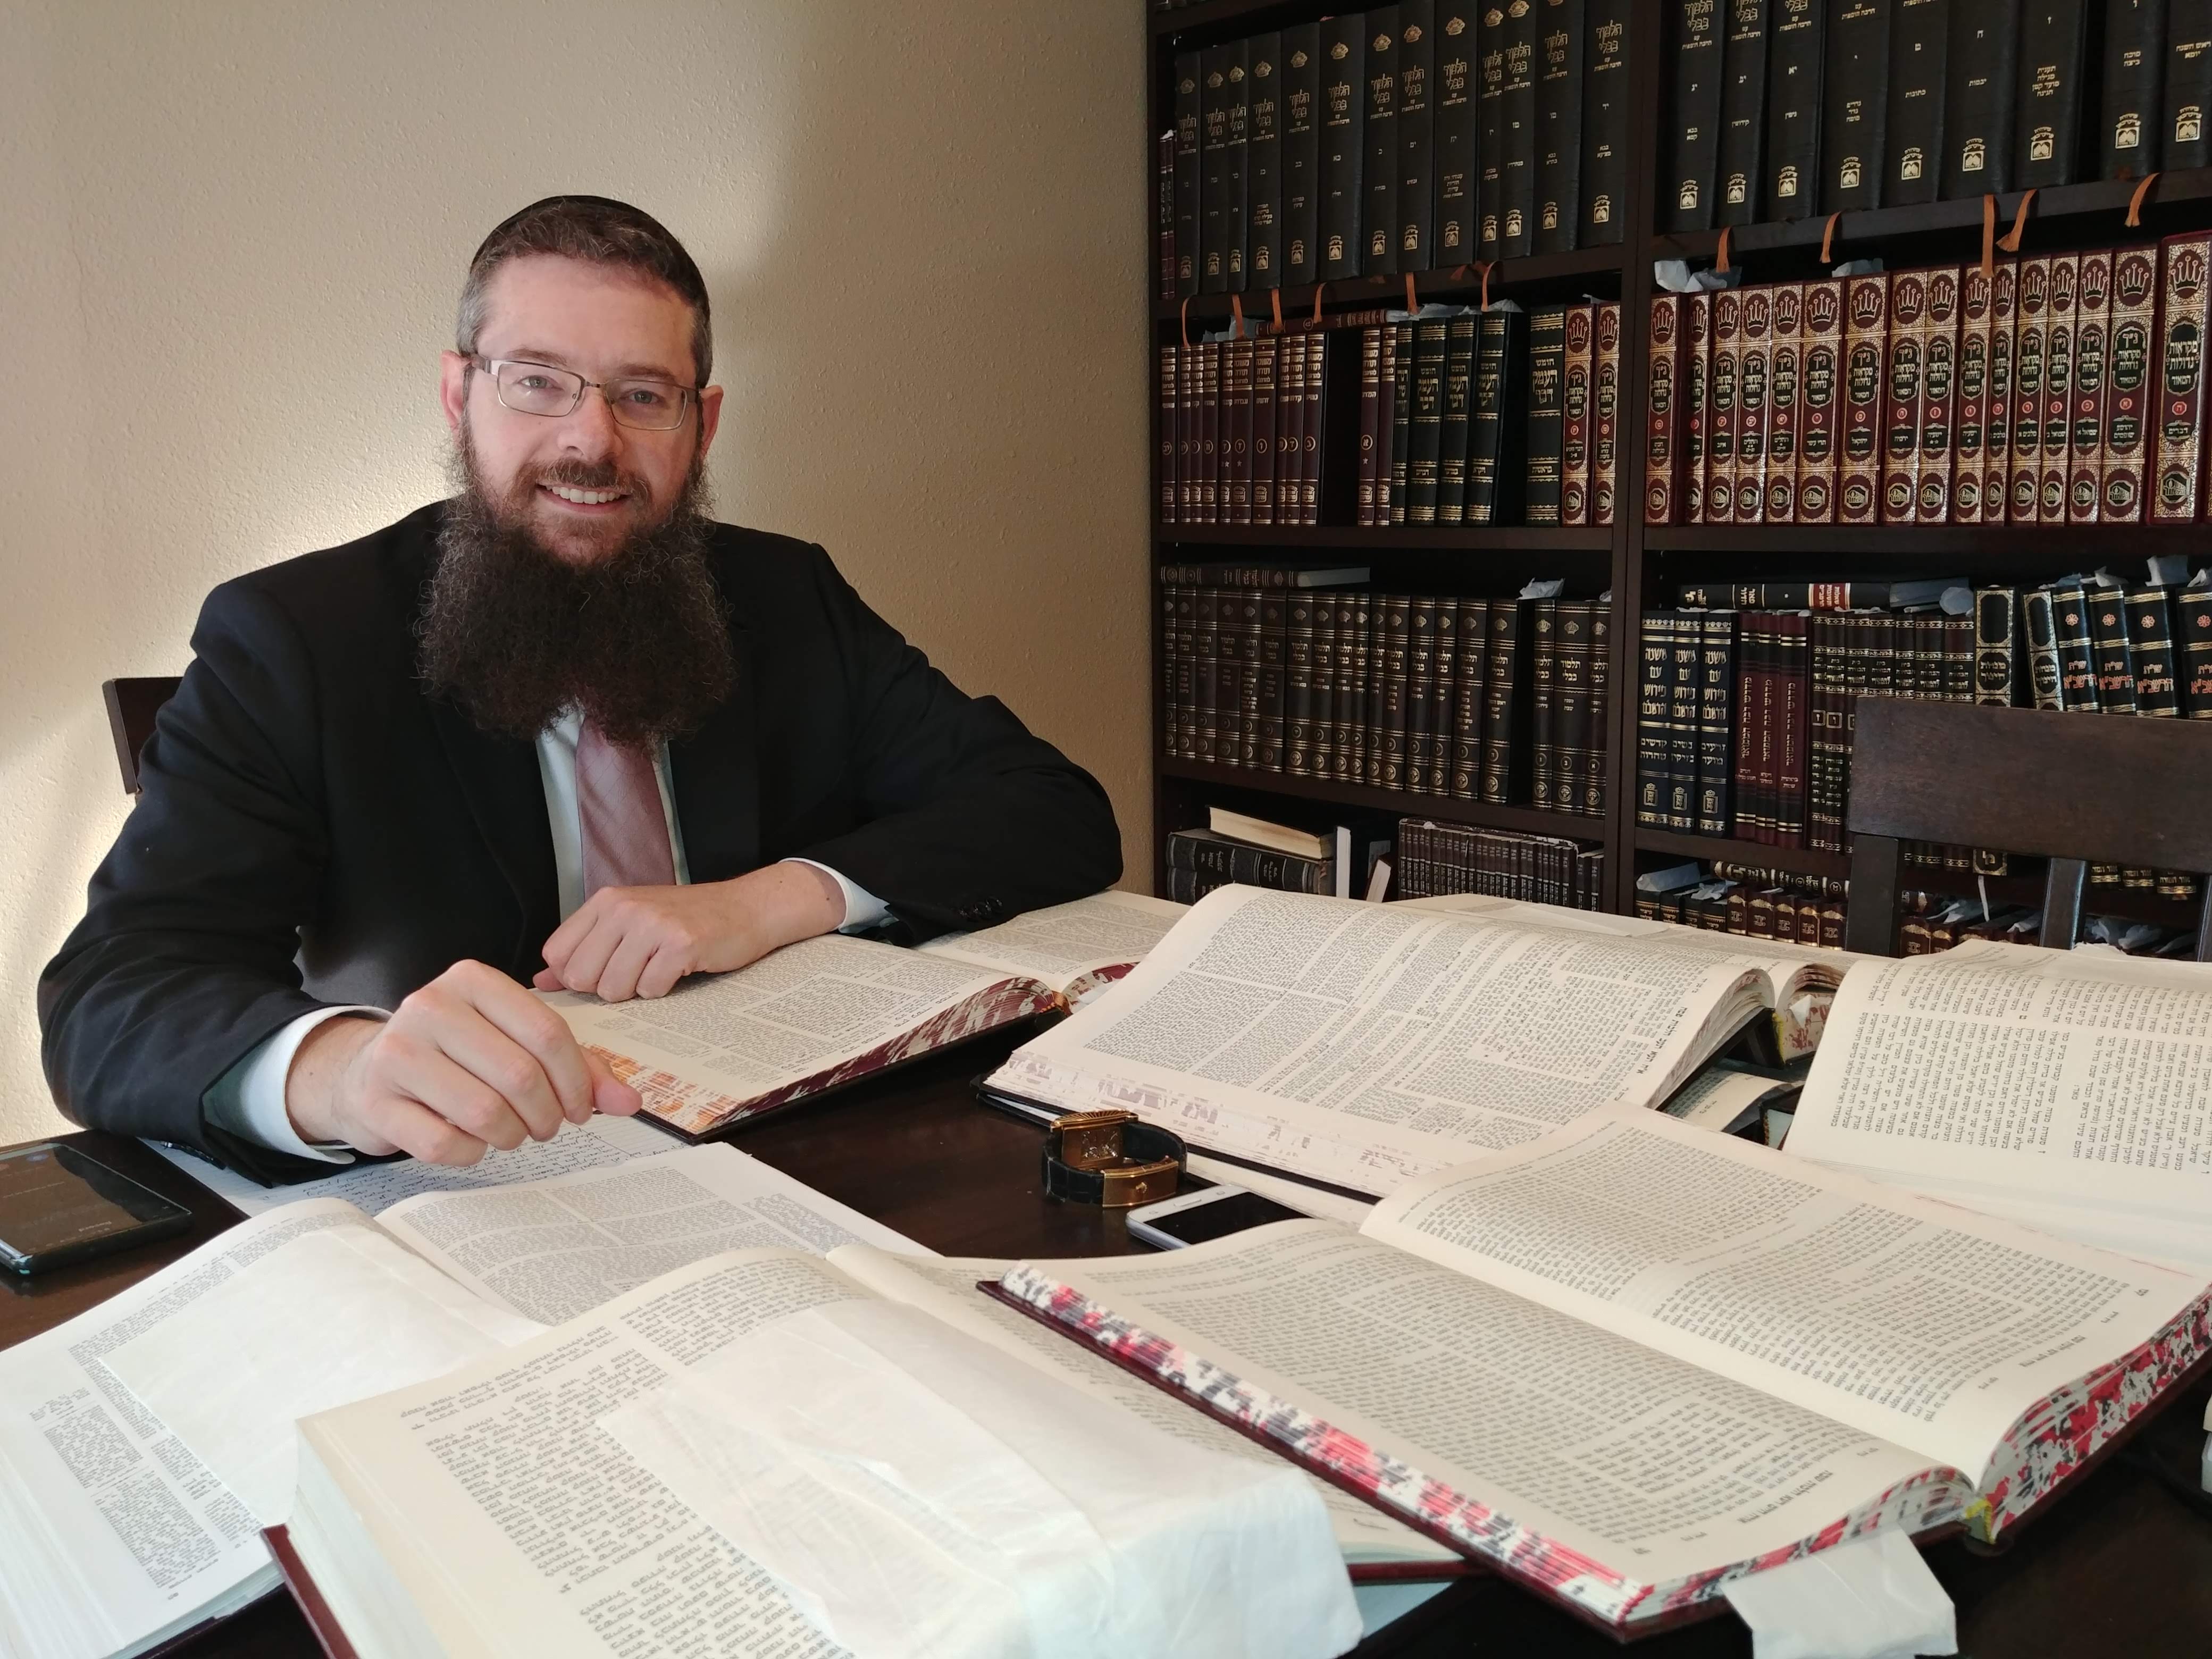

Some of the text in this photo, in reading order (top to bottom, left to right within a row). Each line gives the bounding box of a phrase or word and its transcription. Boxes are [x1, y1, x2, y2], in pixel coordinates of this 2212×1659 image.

[1905, 89, 1926, 98] כתובות
[2168, 340, 2199, 356] מקראות
[2168, 356, 2196, 370] גדולות
[1534, 370, 1557, 394] העמק
[2172, 375, 2191, 384] המאור
[1646, 648, 1666, 661] משנה
[1561, 657, 1580, 668] תלמוד
[1563, 670, 1577, 681] בבלי
[1649, 666, 1662, 678] עם
[1679, 668, 1690, 680] עם
[1641, 738, 1667, 747] קדשים
[1913, 1111, 1920, 1119] אם
[2142, 1117, 2152, 1125] לא
